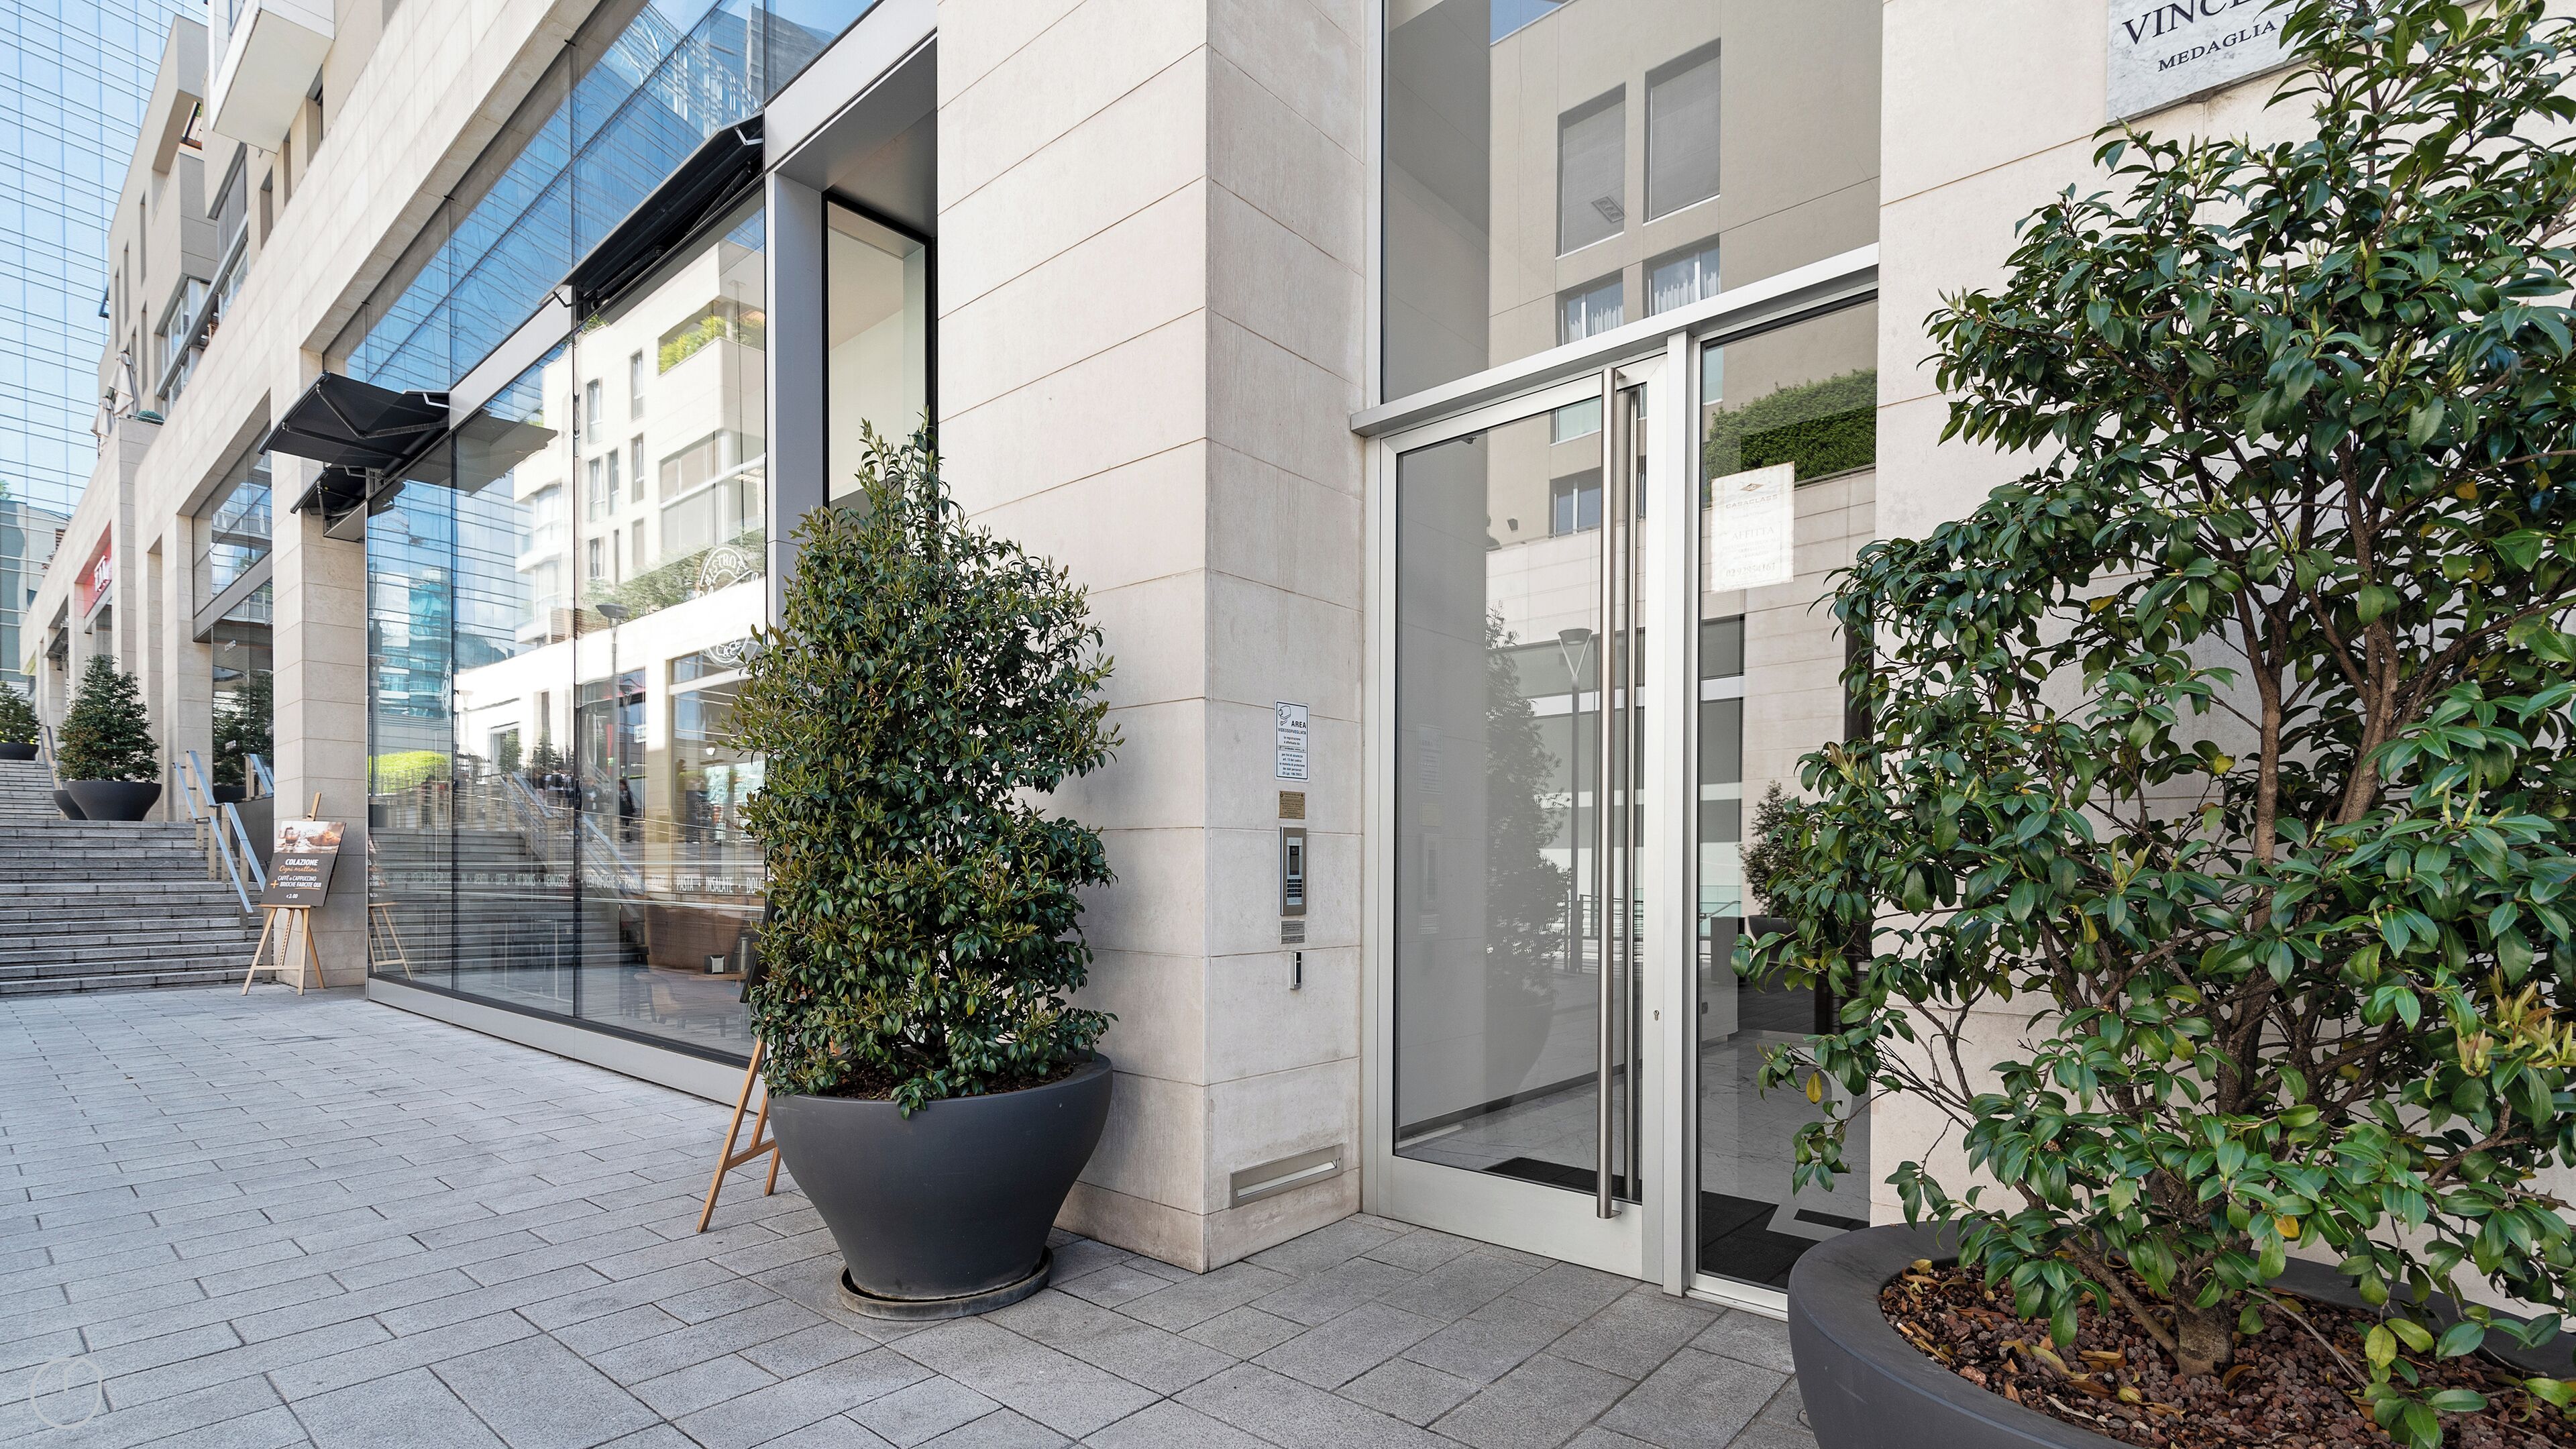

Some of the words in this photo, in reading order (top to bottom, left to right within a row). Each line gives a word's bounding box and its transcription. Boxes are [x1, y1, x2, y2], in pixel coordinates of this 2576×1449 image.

[2157, 20, 2277, 72] MEDAGLIA
[704, 553, 745, 586] BISTROT
[279, 865, 292, 873] Ogni
[586, 874, 615, 889] CENTRIFUGHE
[625, 875, 641, 890] PANINI
[676, 875, 694, 892] PASTA
[706, 876, 733, 893] INSALATE
